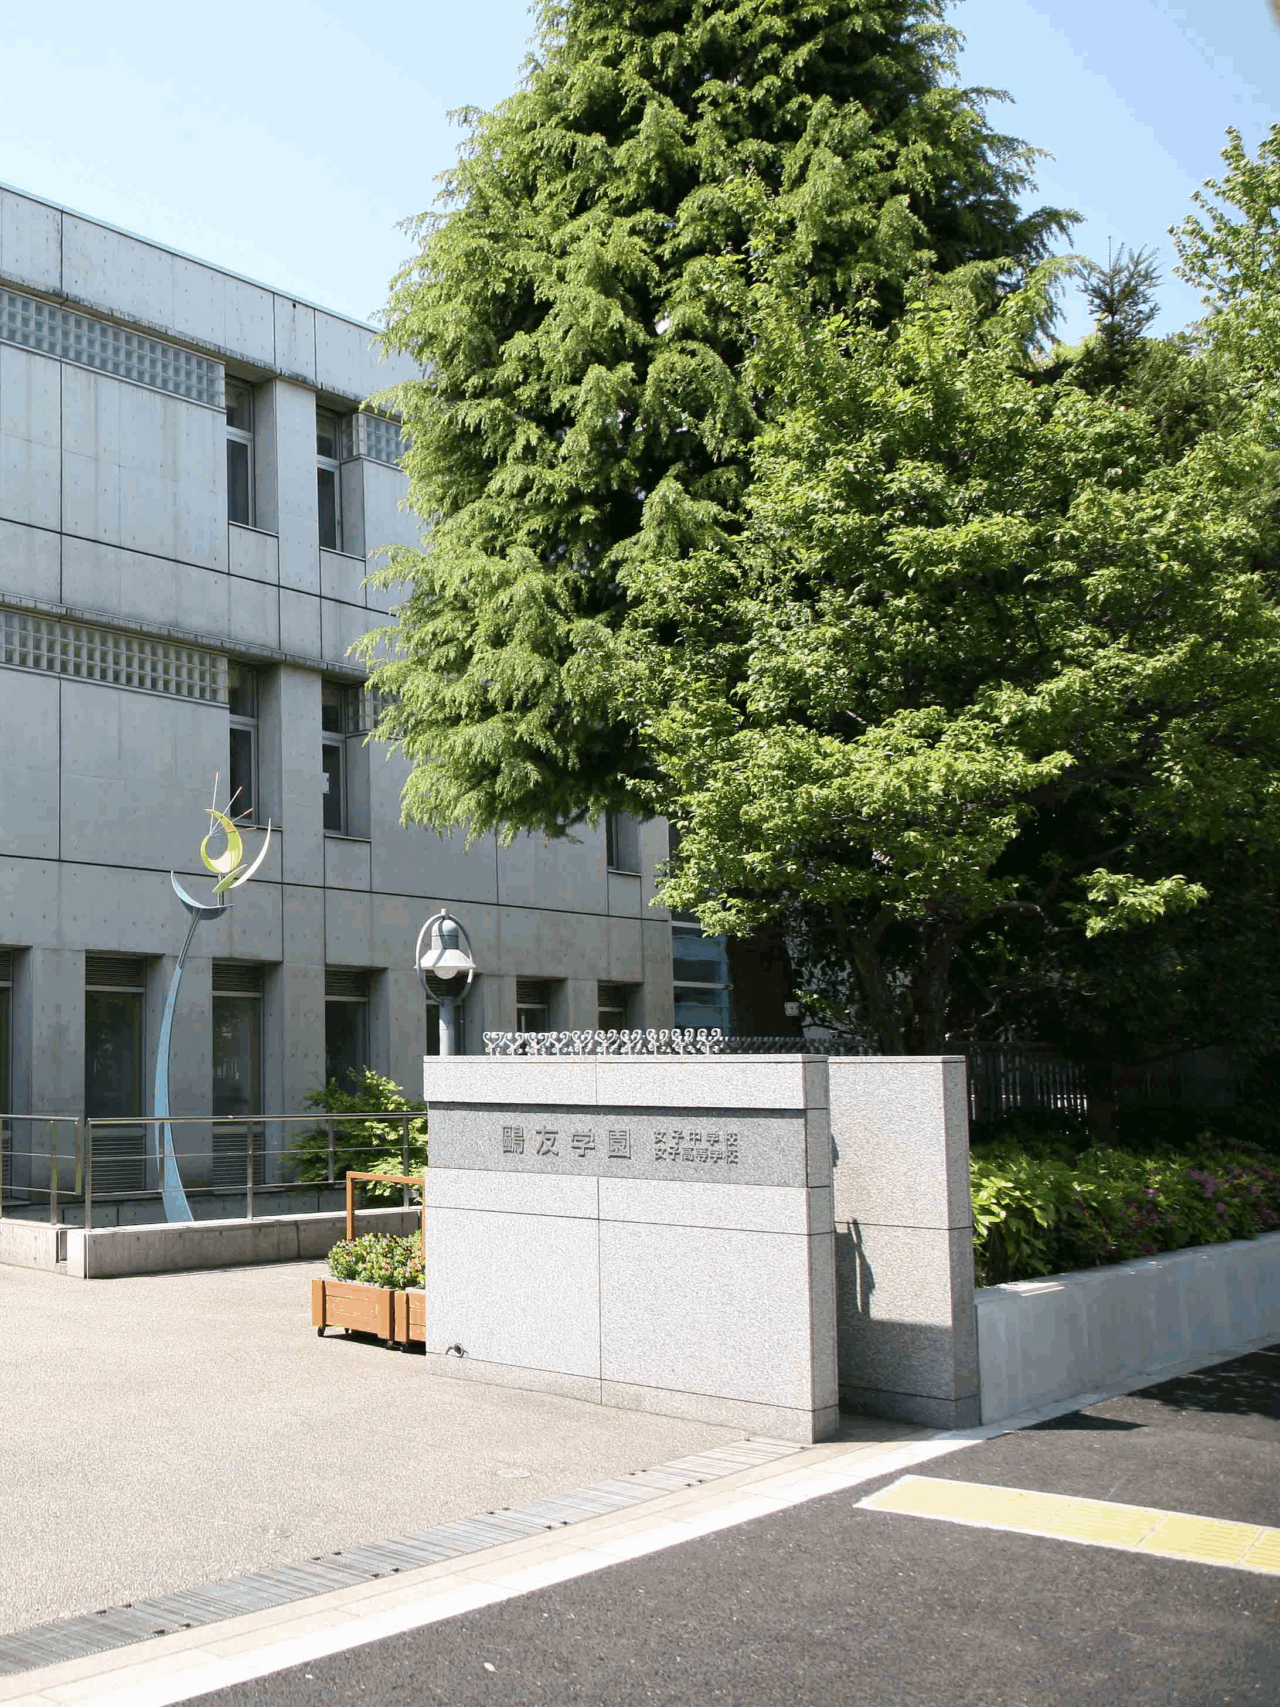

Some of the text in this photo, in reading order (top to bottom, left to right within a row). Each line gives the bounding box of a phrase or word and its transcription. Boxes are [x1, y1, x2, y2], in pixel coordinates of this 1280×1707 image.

[654, 1129, 738, 1148] 女子中学校
[654, 1146, 739, 1165] 女子高等学校
